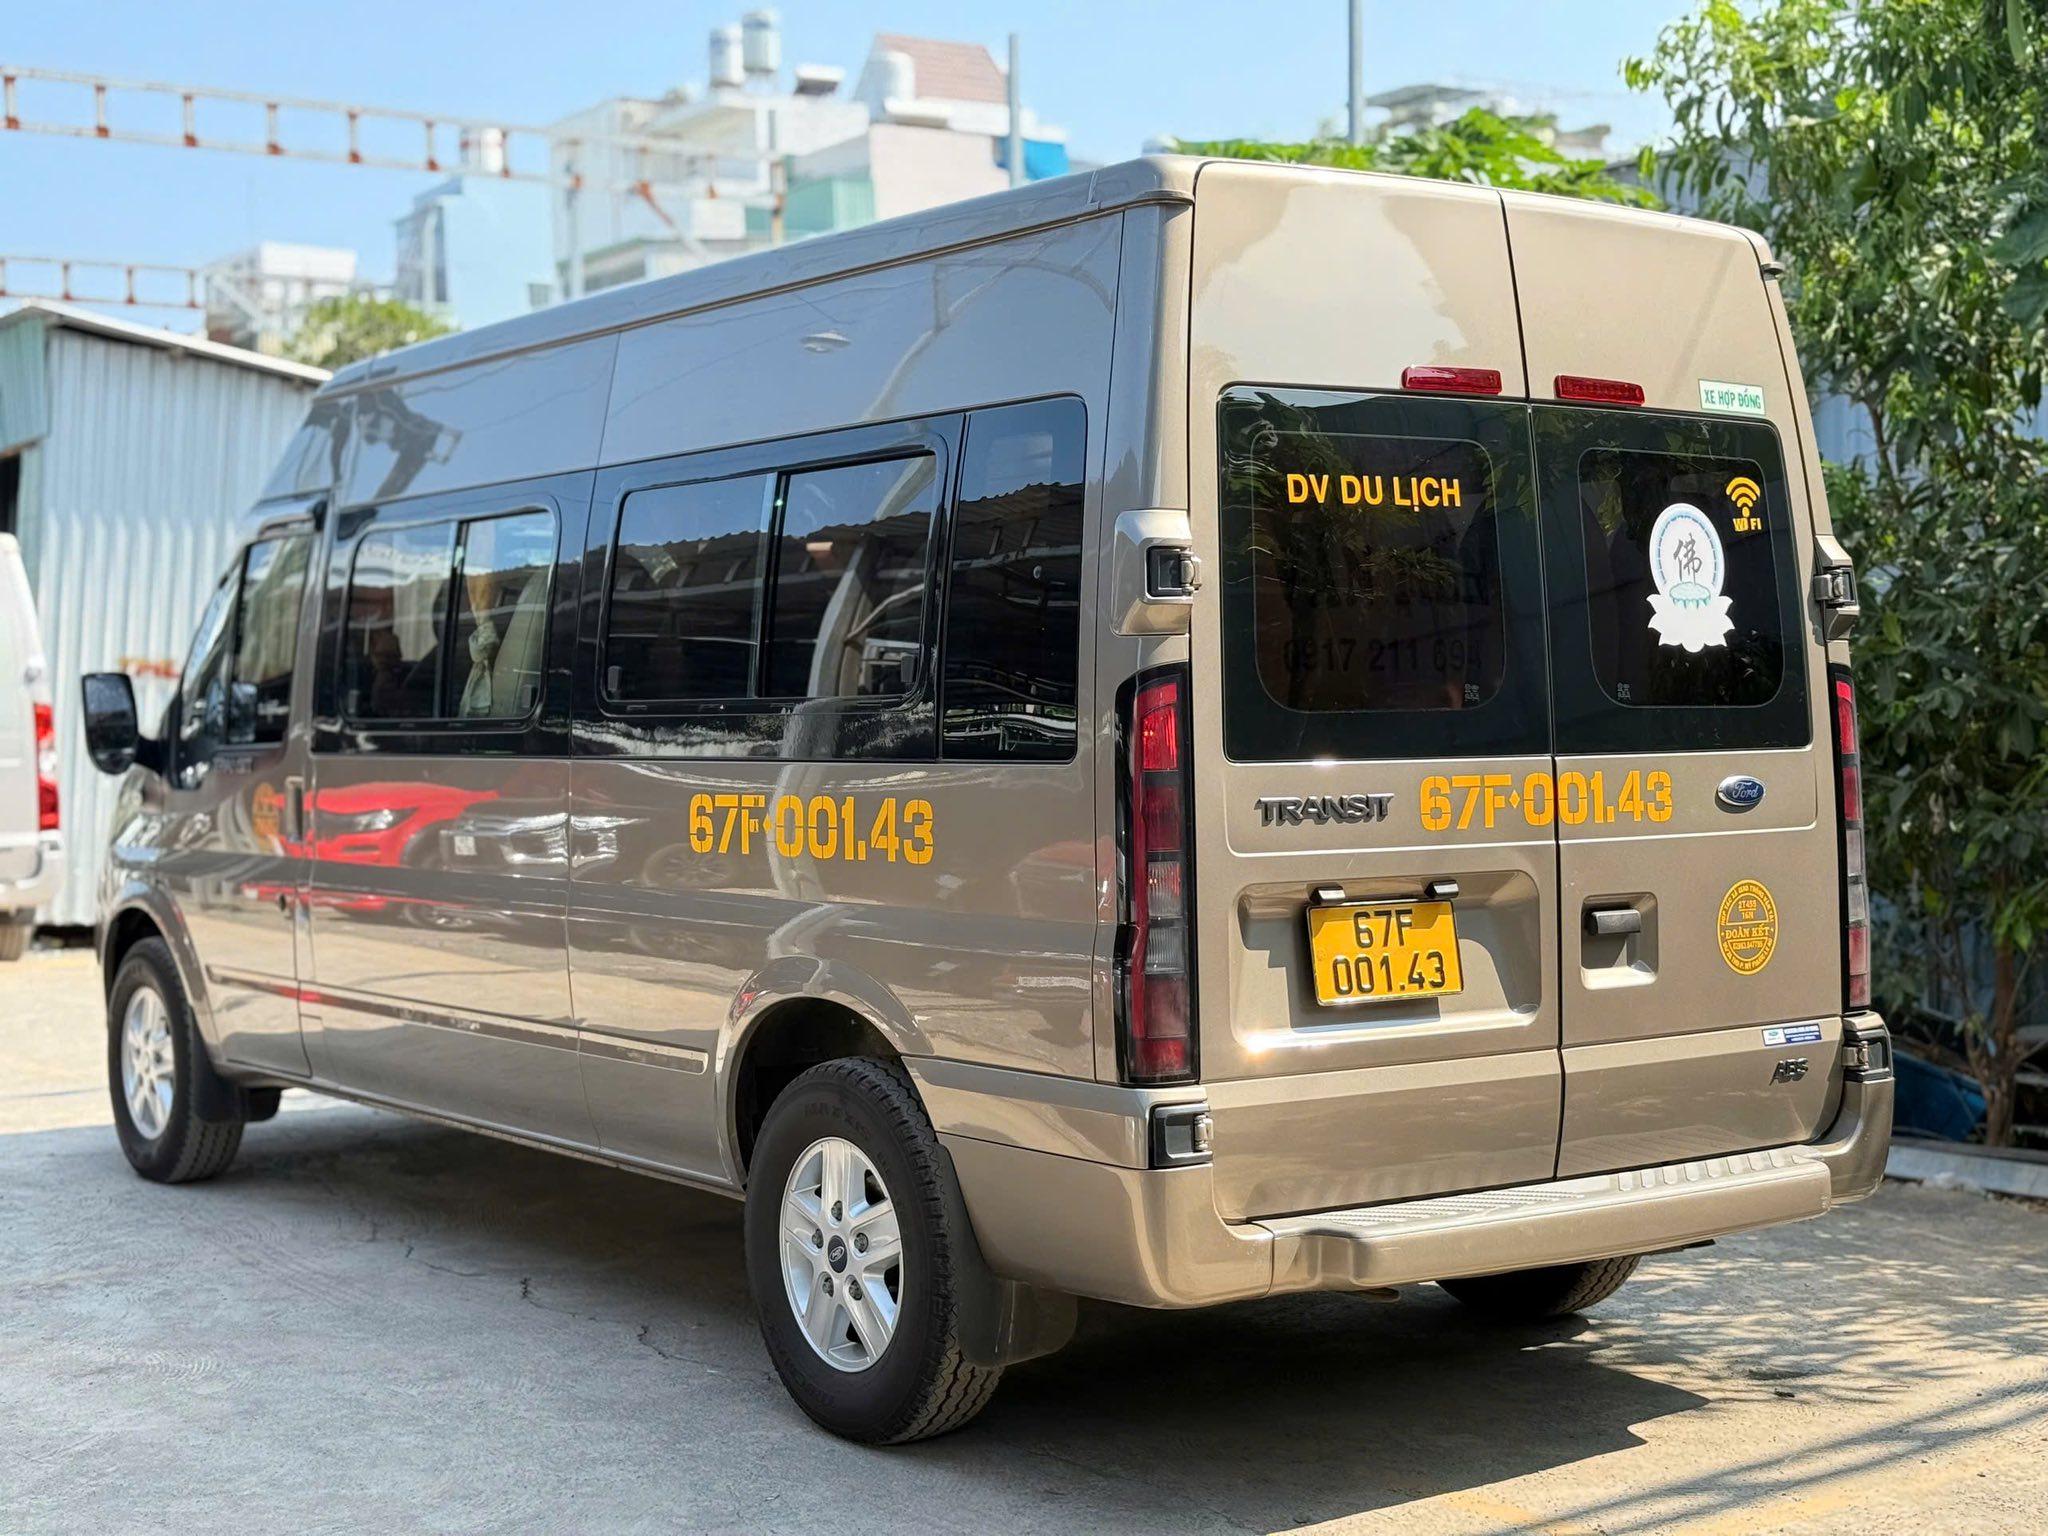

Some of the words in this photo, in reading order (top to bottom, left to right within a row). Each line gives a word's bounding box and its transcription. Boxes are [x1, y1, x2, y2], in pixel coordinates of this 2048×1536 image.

[1704, 389, 1716, 404] XE
[1287, 474, 1329, 503] DV
[1340, 475, 1383, 505] DU
[1393, 476, 1461, 512] LỊCH
[1254, 793, 1395, 826] TRANSIT
[1353, 908, 1413, 949] 67F
[1725, 926, 1750, 940] ĐOÀN
[1333, 950, 1446, 995] 001.43
[1769, 1058, 1808, 1084] ABS
